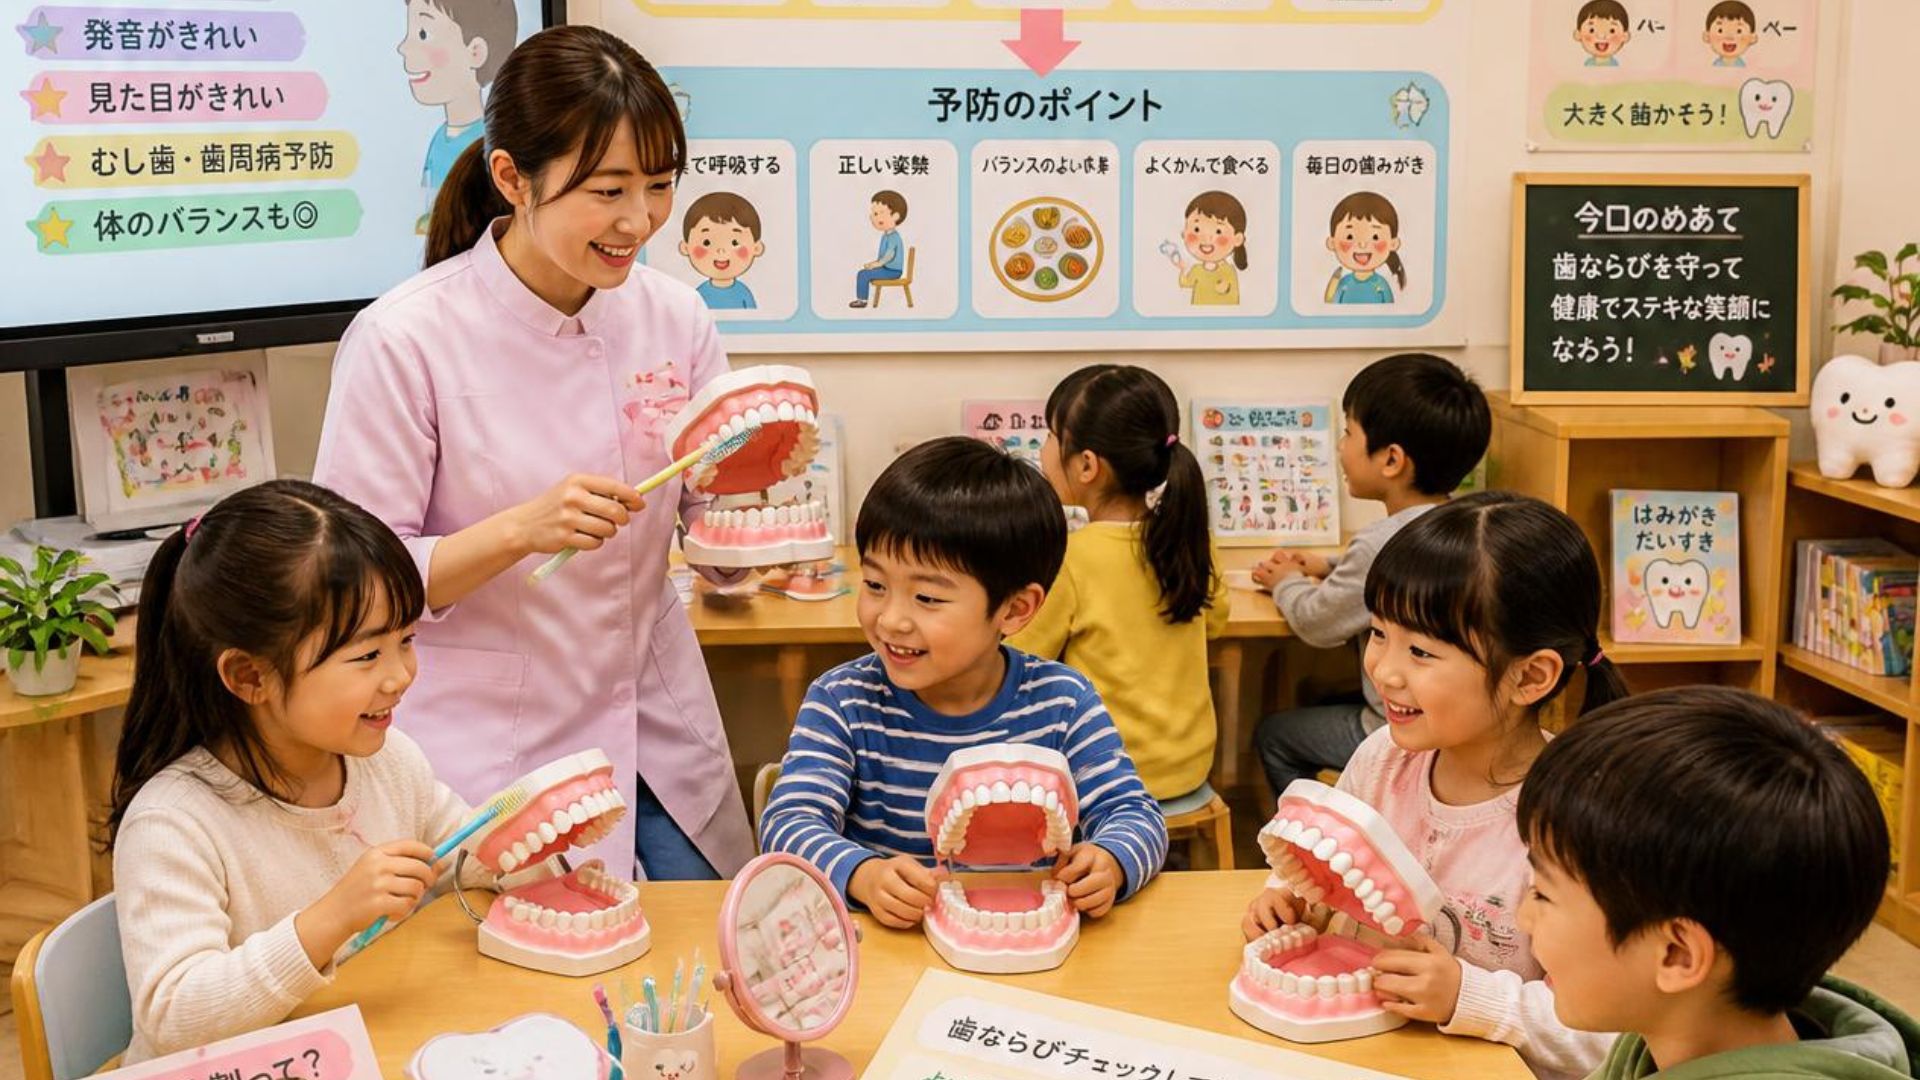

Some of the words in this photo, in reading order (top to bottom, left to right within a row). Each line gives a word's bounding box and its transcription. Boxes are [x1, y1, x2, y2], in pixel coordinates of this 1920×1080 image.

[84, 18, 258, 51] 発音がきれい
[89, 82, 284, 114] 見た目がきれい
[928, 86, 1162, 123] 予防のポイント
[91, 141, 334, 177] むし歯・歯周病予防
[683, 154, 780, 176] で呼吸する
[1305, 155, 1424, 176] 毎日の歯みがき
[1552, 251, 1743, 281] 歯ならびを守って
[1634, 504, 1716, 527] はみがき
[1636, 530, 1713, 553] だいすき
